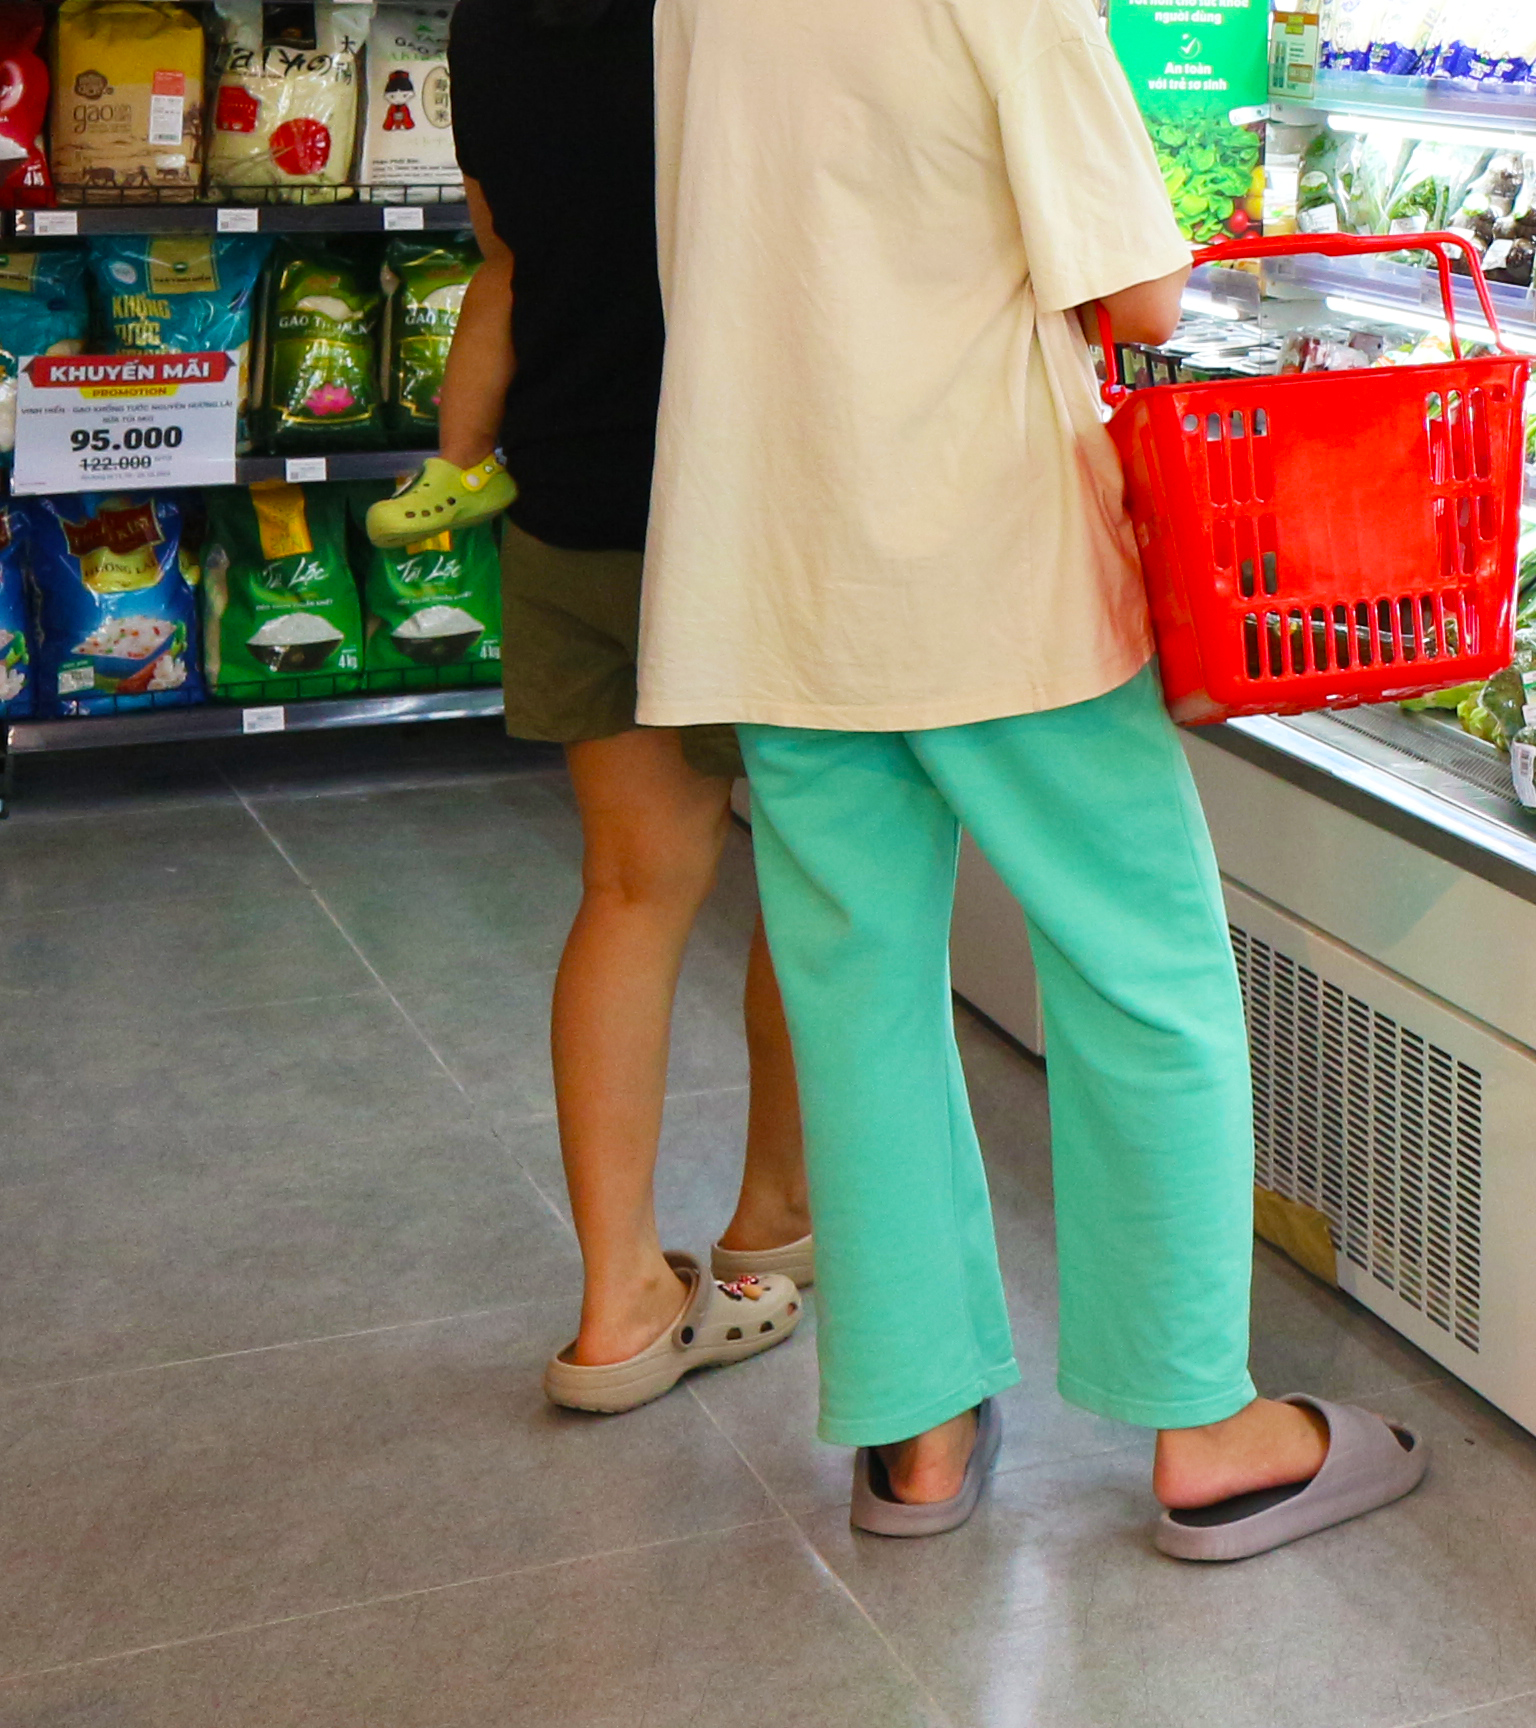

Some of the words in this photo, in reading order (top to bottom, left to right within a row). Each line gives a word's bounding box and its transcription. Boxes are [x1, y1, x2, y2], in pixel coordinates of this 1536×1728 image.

[50, 359, 154, 382] KHUYẾN
[163, 358, 210, 379] MÃI
[92, 387, 167, 397] PROMOTION
[70, 426, 182, 452] 95.000
[80, 456, 152, 471] 122.000
[479, 644, 501, 660] 4kg
[338, 652, 358, 671] 4kg
